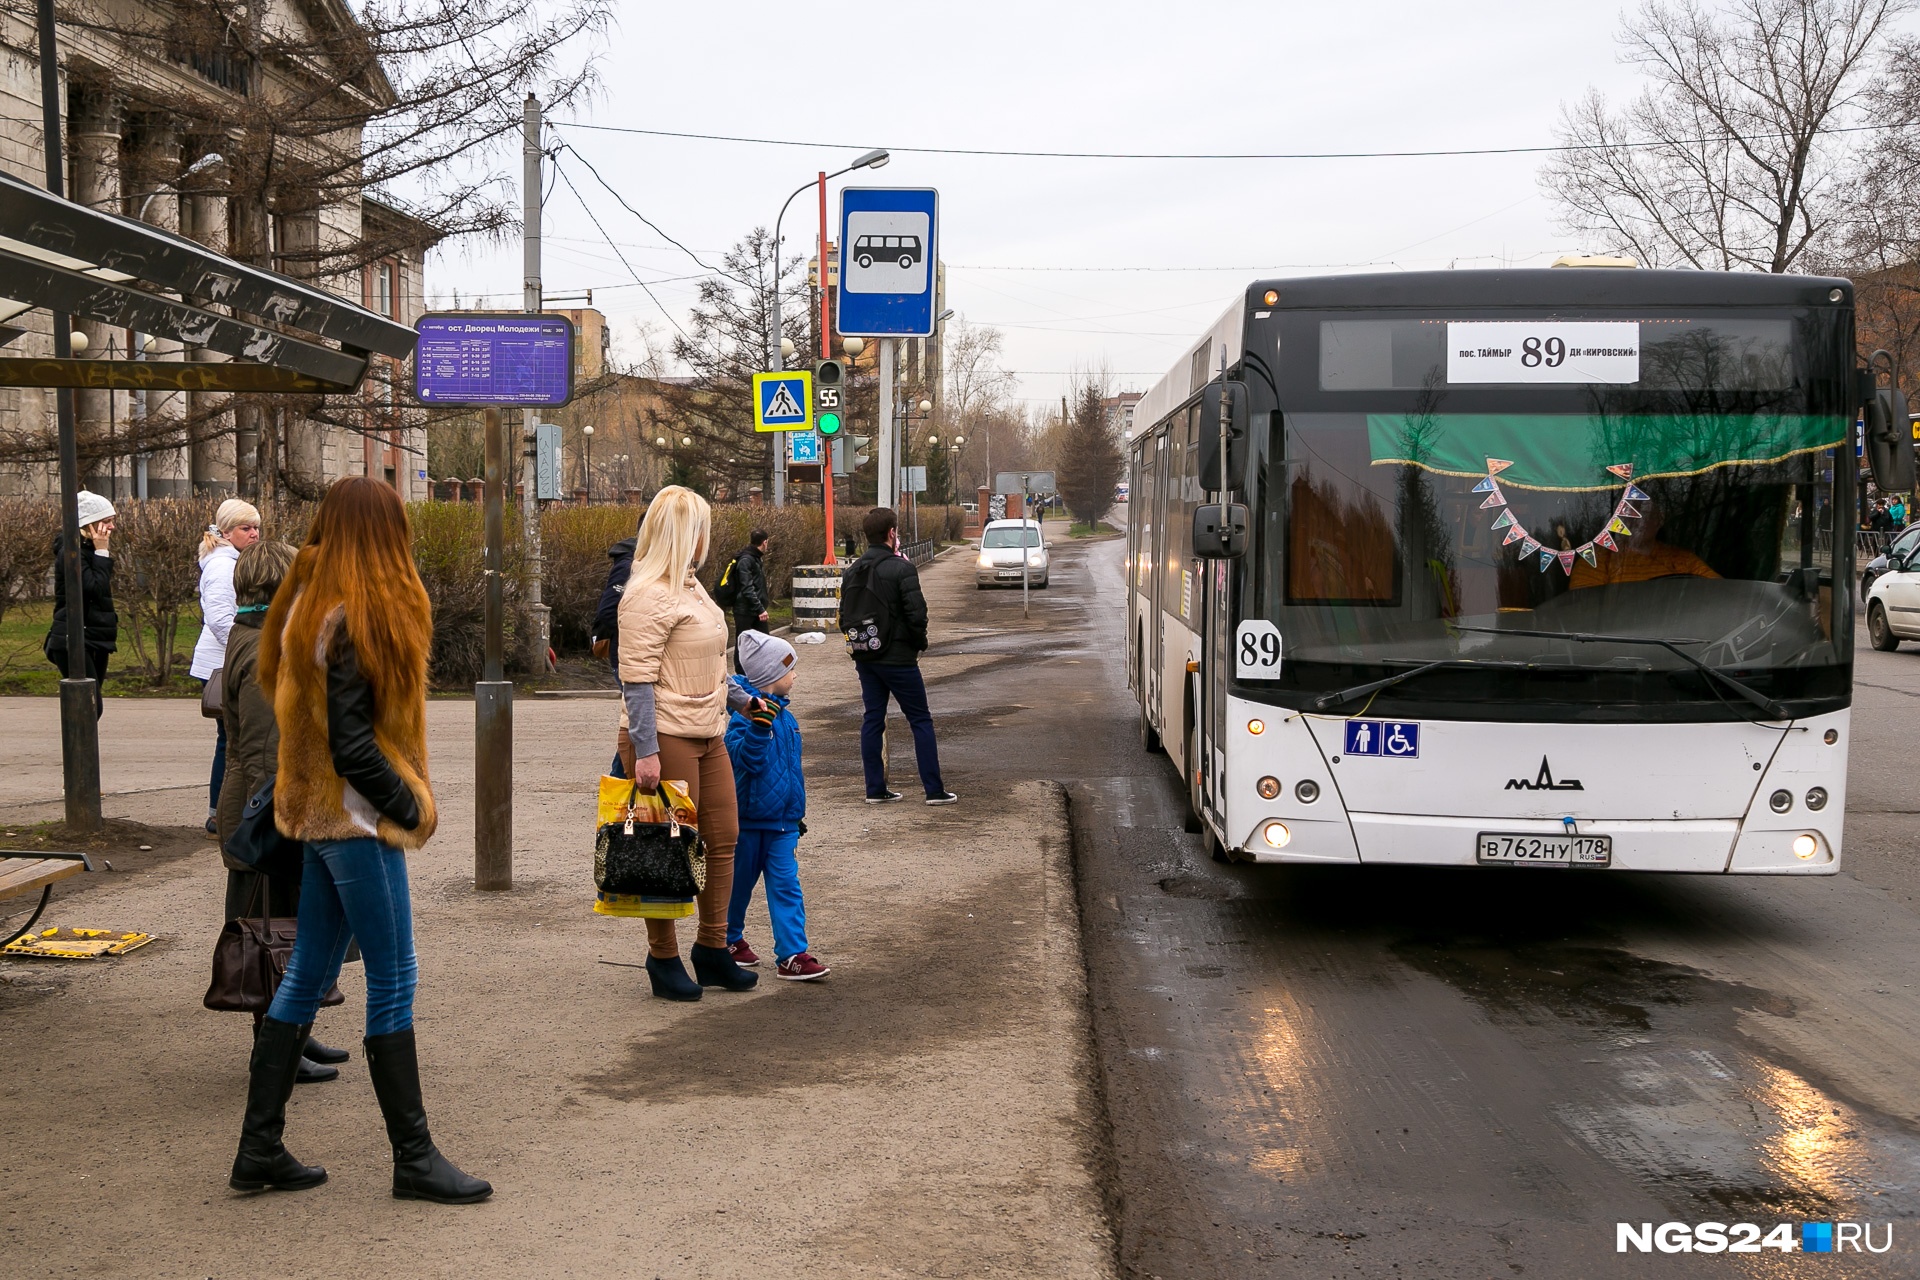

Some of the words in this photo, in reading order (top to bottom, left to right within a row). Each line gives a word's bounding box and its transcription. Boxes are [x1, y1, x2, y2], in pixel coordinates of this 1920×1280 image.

[465, 324, 496, 334] Дворец
[498, 325, 540, 334] Молодежи
[1477, 348, 1512, 358] ТАЙМЫР
[1521, 336, 1566, 368] 89
[1569, 348, 1581, 357] ДК
[1582, 347, 1637, 357] «КИРОВСКИЙ»
[820, 389, 838, 407] 55
[1241, 632, 1280, 667] 89
[1574, 839, 1604, 855] 178
